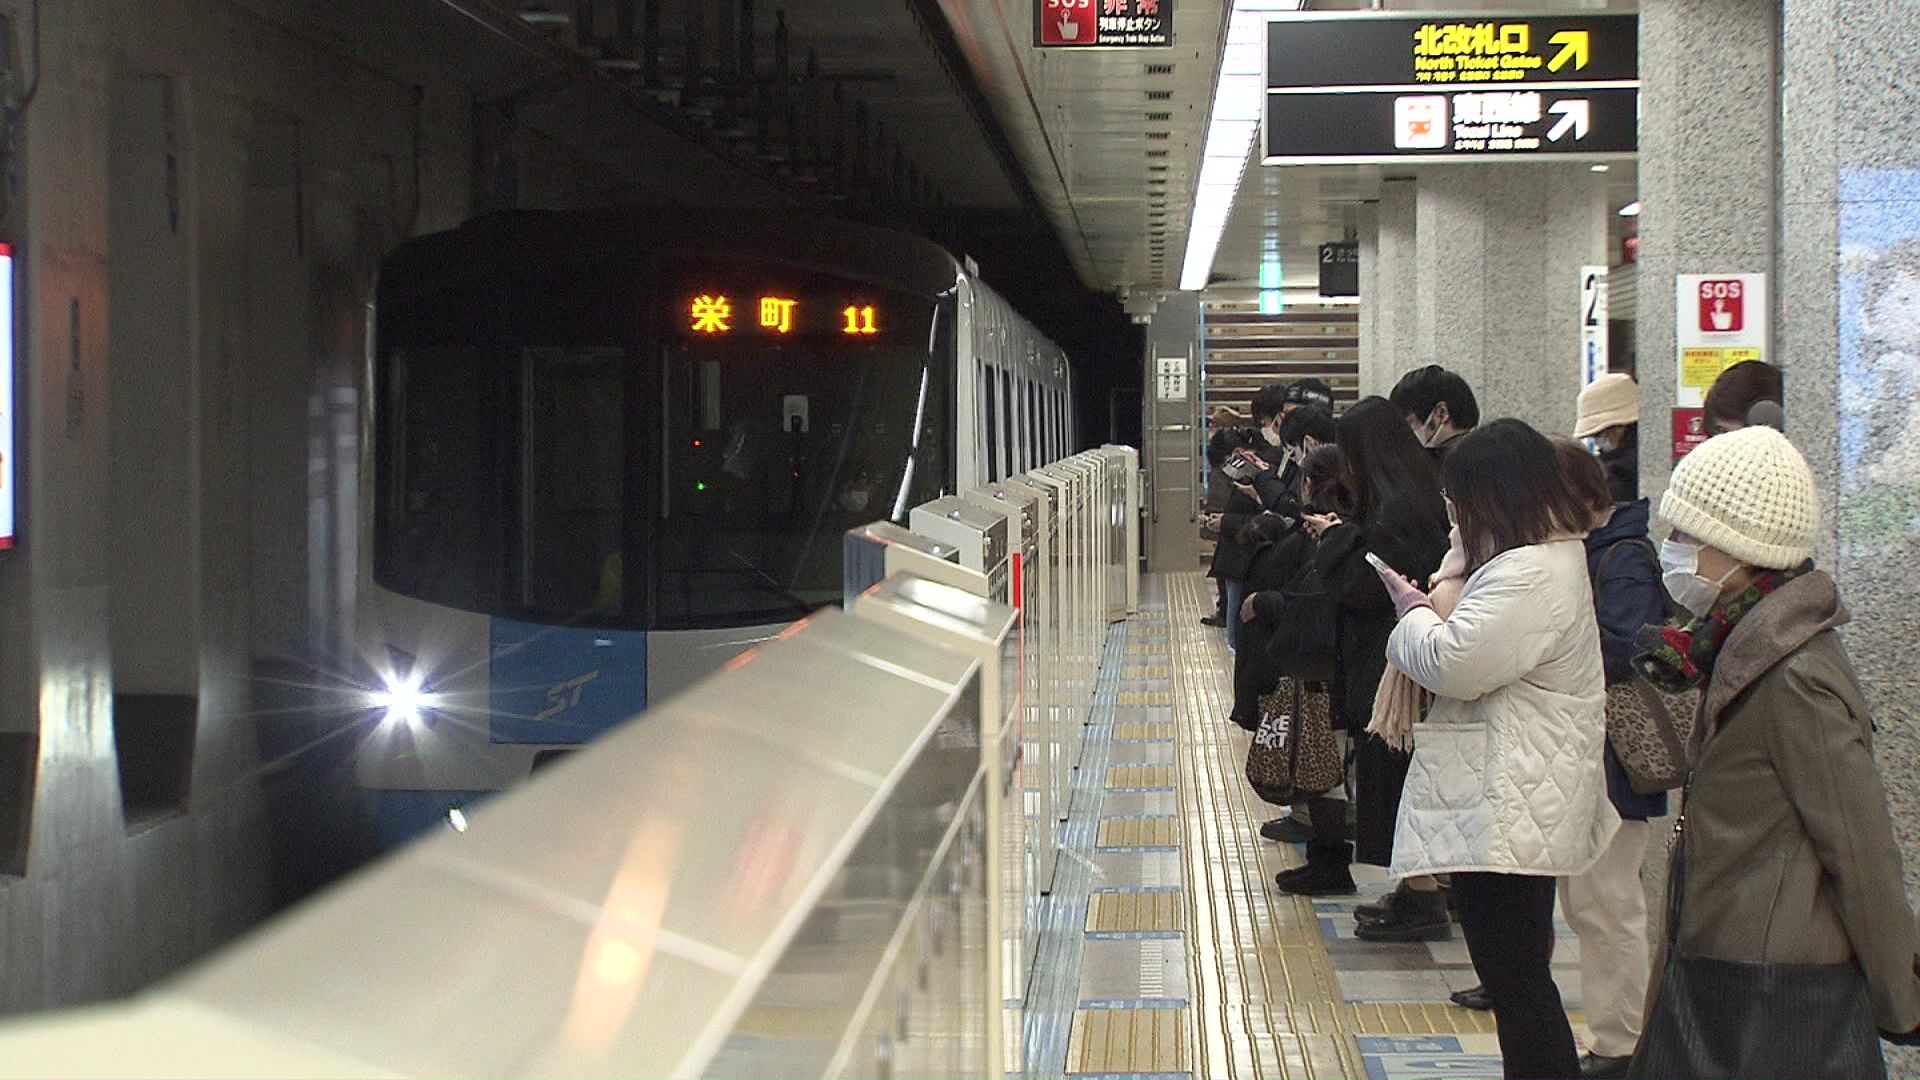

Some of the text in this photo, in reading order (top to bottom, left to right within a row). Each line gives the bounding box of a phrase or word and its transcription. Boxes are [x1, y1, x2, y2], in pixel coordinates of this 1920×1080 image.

[1414, 23, 1529, 55] 北改札口
[1415, 54, 1542, 70] North Ticket Gates
[1323, 247, 1334, 264] 2
[1702, 282, 1742, 299] SOS
[692, 295, 799, 334] 栄町
[843, 306, 879, 333] 11
